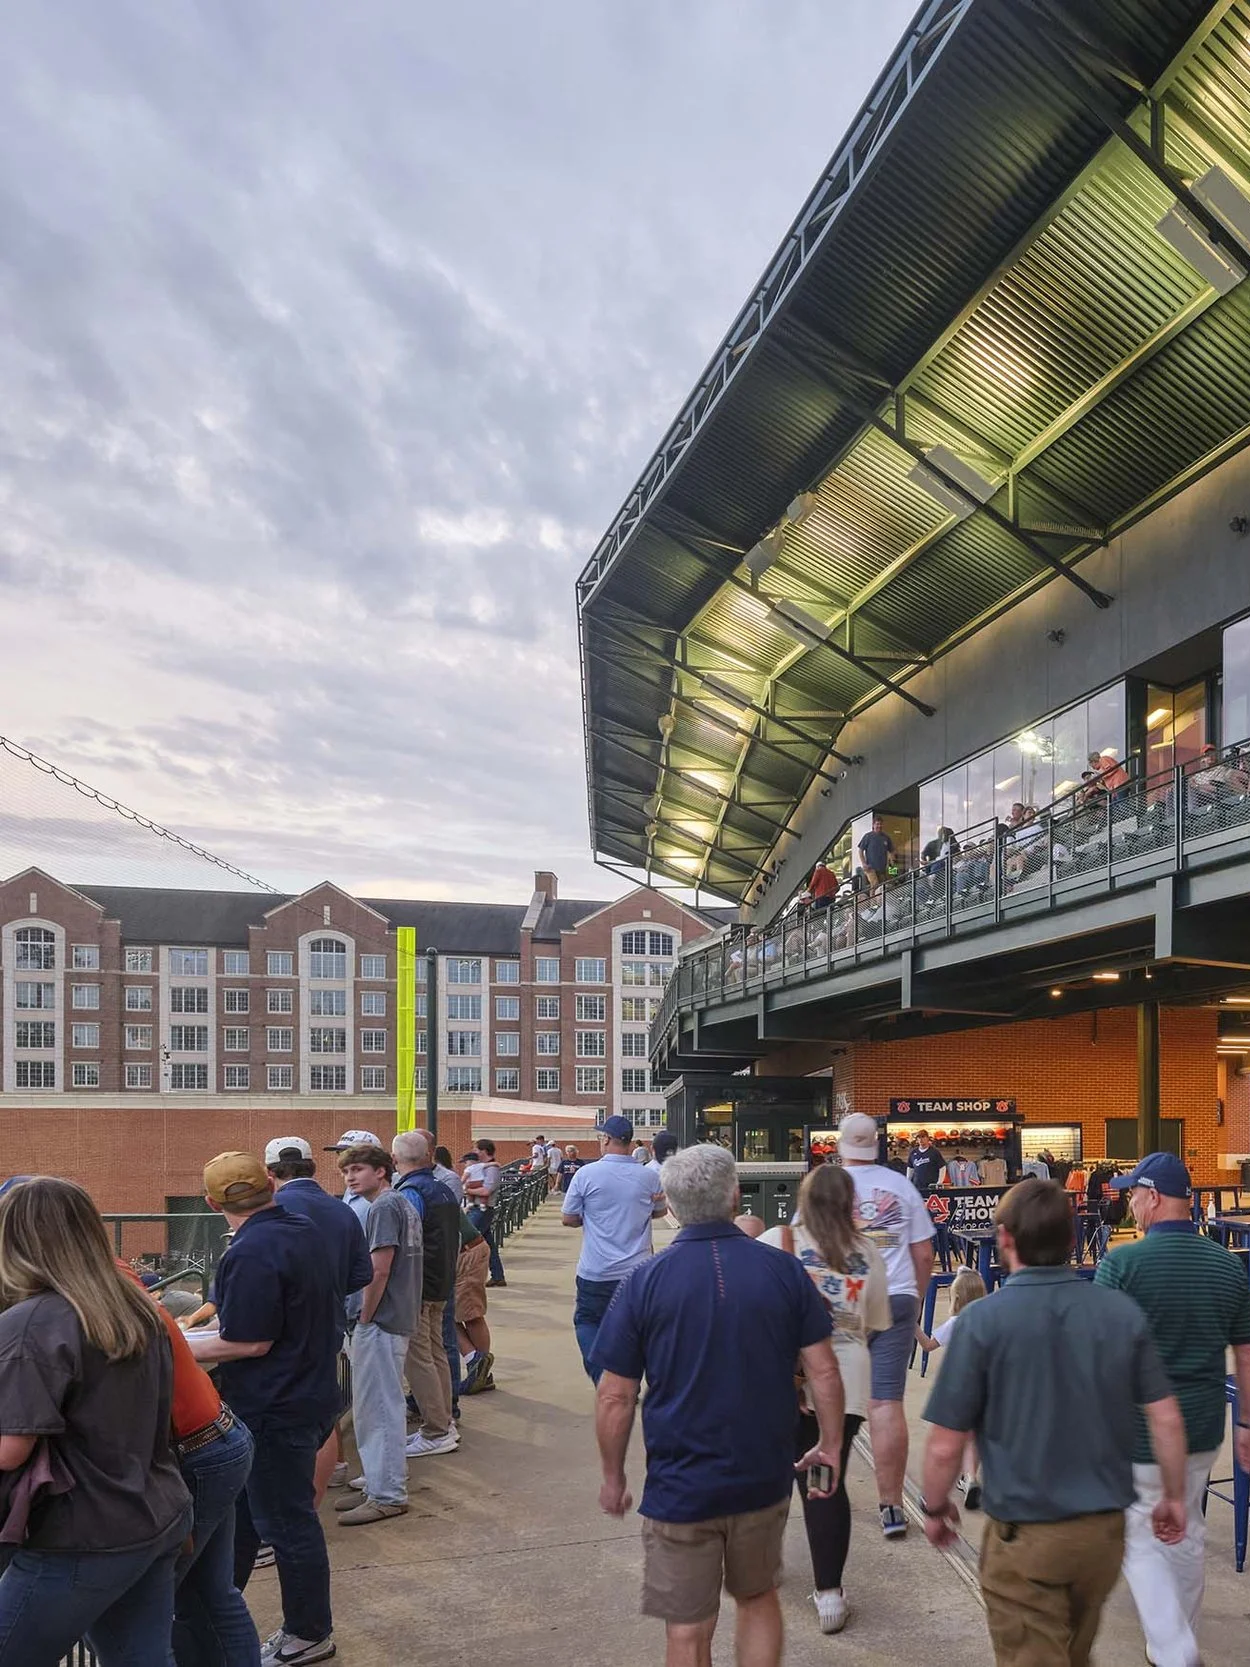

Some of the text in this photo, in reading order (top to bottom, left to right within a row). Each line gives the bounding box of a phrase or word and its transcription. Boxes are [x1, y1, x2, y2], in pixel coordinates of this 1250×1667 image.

[917, 1102, 952, 1112] TEAM
[956, 1102, 991, 1111] SHOP
[954, 1195, 999, 1207] TEAM
